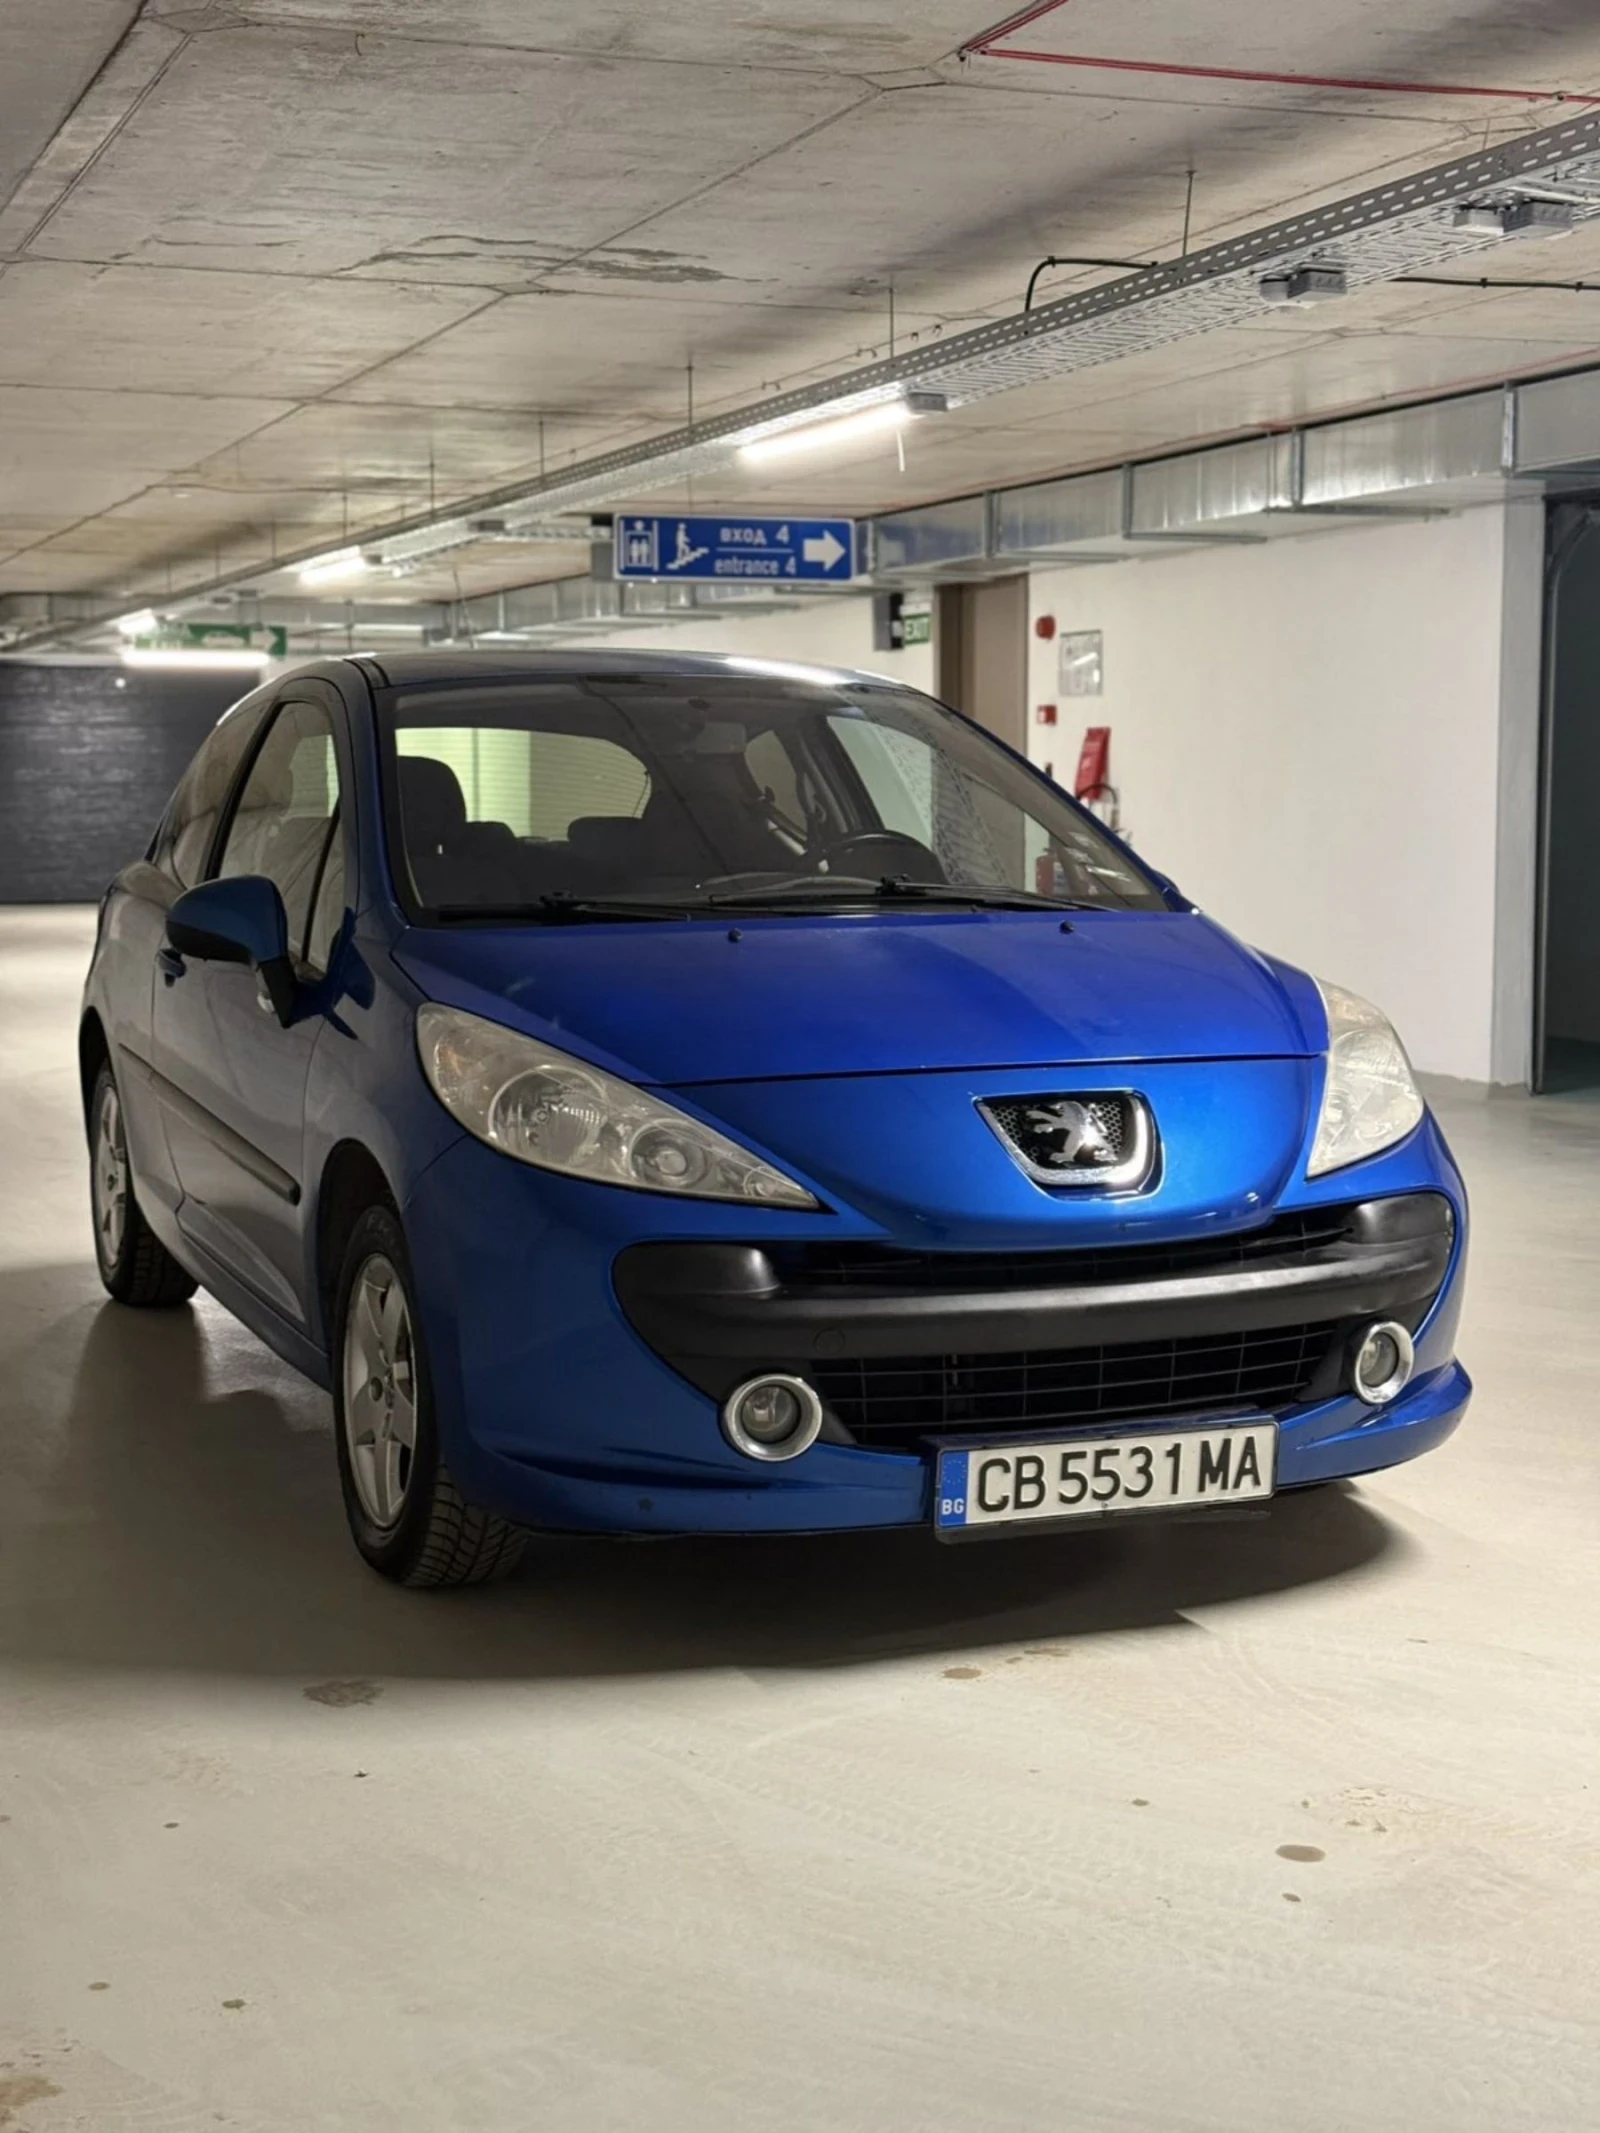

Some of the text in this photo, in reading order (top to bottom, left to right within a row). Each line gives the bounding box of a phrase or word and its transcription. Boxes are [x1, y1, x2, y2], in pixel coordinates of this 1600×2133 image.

[775, 524, 790, 544] 4
[714, 556, 796, 575] entrance 4
[978, 1436, 1261, 1513] CB 5531 MA
[941, 1498, 965, 1516] BG
